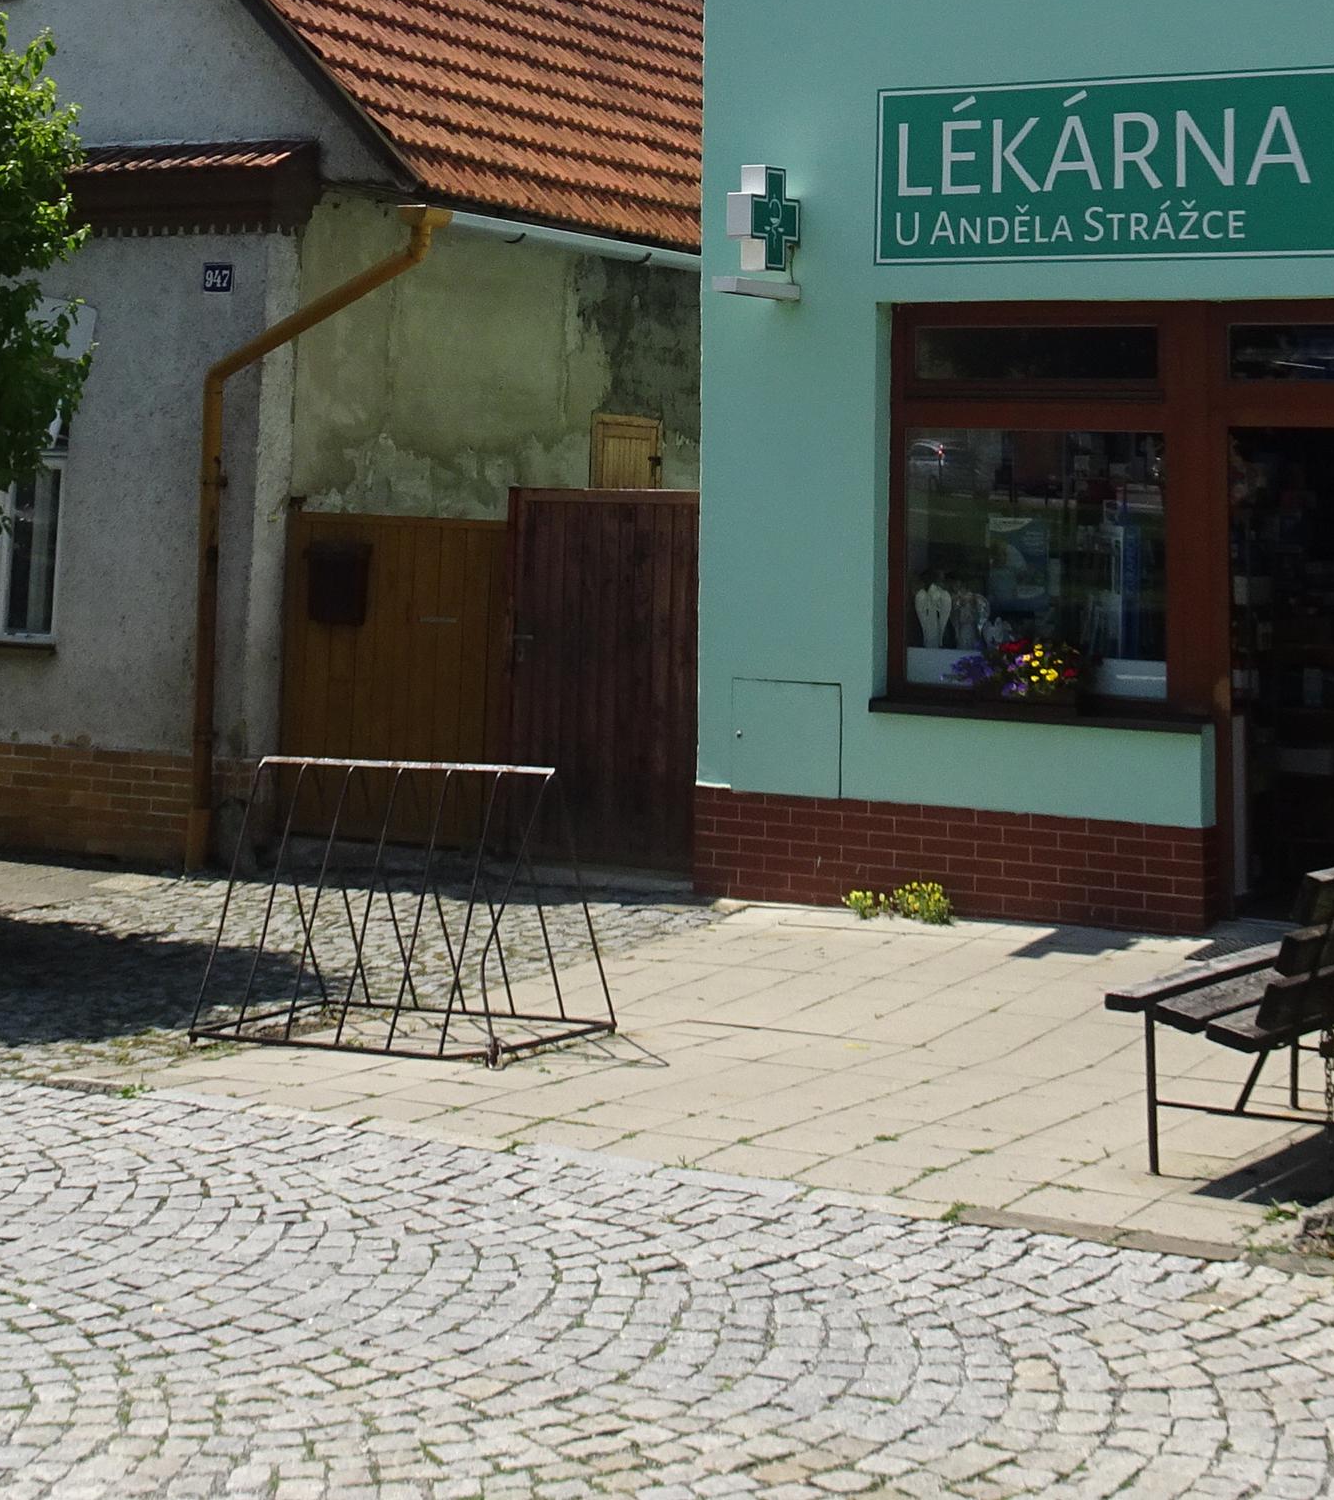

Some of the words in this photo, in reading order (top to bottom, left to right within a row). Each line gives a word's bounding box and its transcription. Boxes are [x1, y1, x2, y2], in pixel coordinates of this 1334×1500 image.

[898, 90, 1311, 197] LÉKÁRNA
[895, 211, 921, 246] U
[929, 204, 1073, 245] ANDĚLA
[1084, 201, 1246, 242] STRÁŽCE
[205, 269, 230, 288] 947
